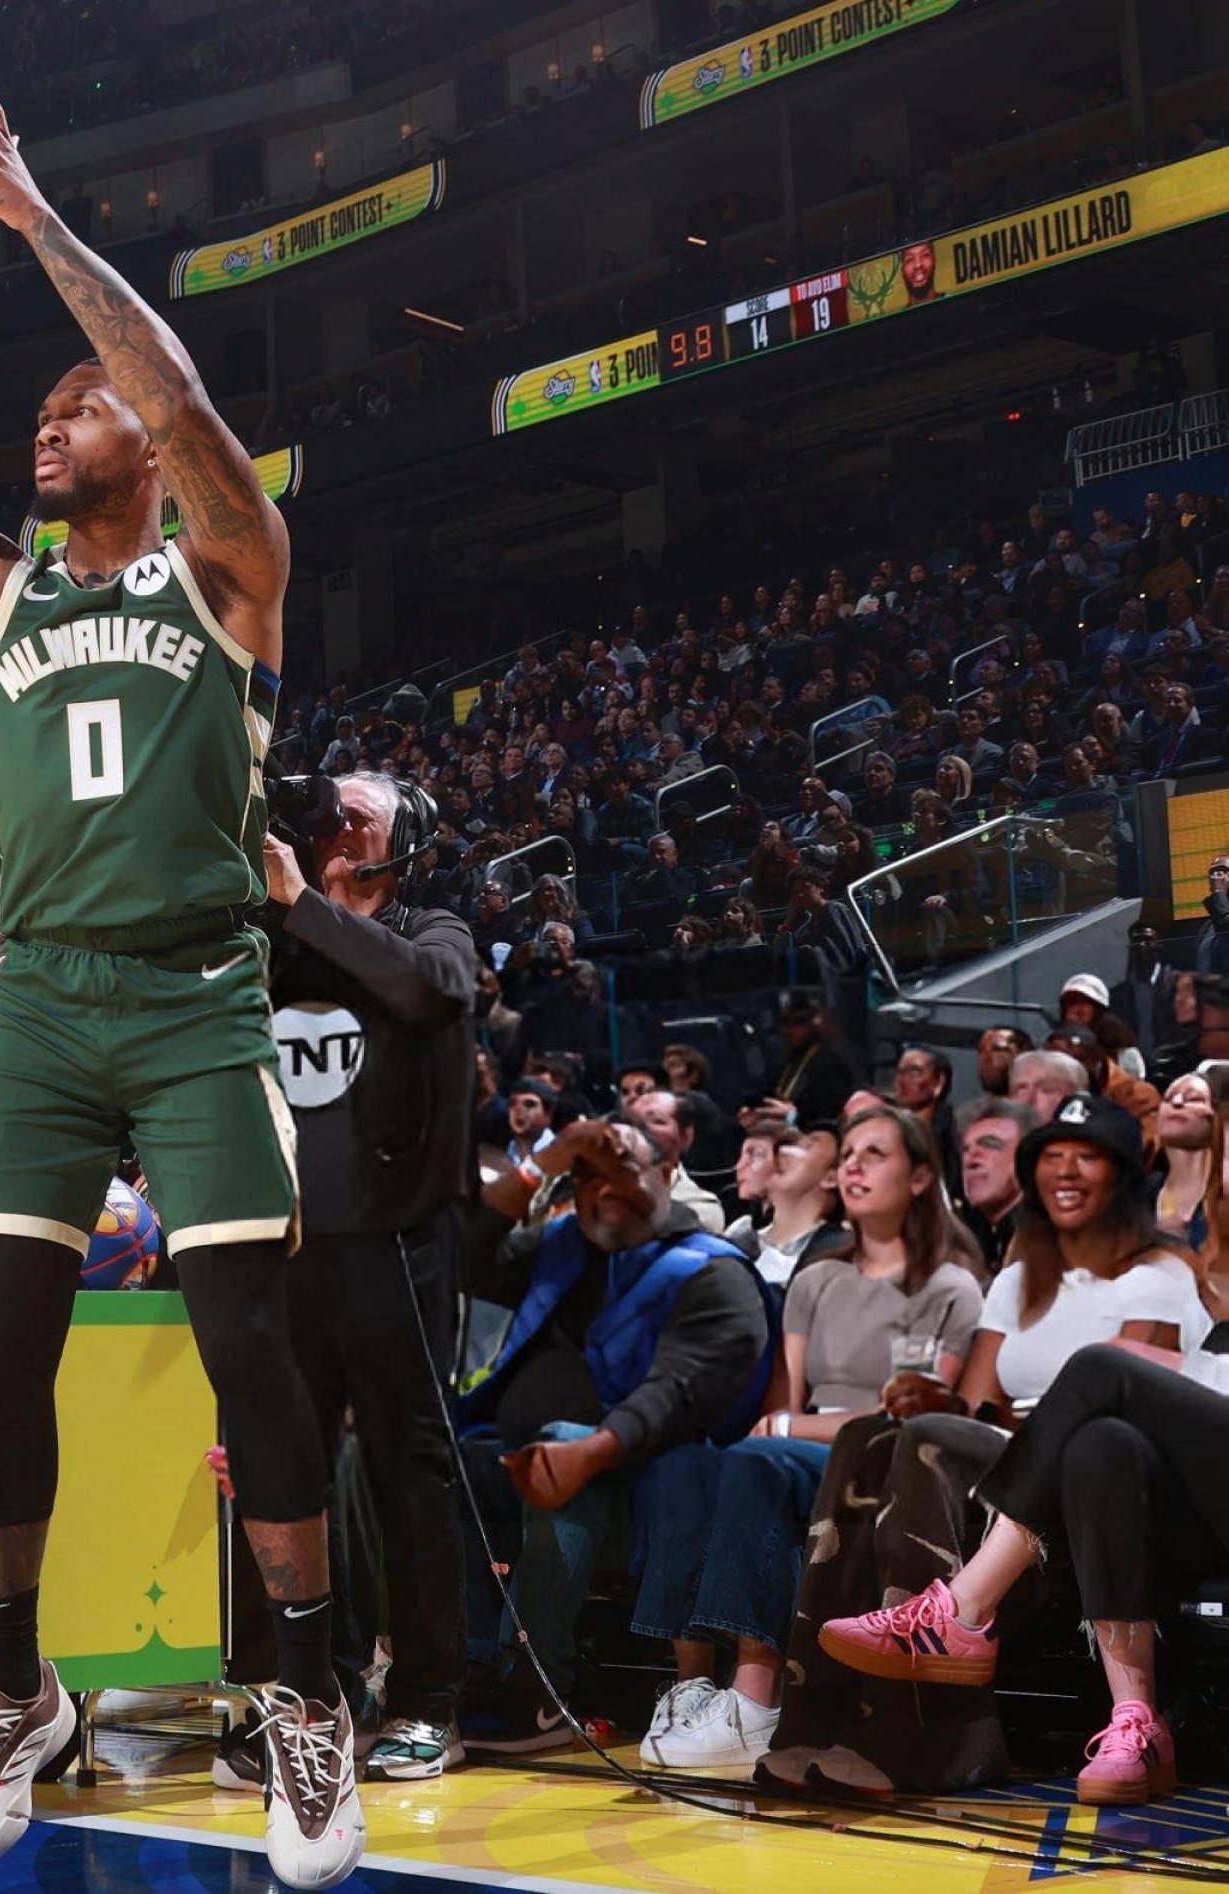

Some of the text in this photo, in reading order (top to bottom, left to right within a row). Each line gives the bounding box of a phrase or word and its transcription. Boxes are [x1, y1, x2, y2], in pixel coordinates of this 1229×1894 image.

[759, 0, 901, 72] 3 POINT CONTEST
[277, 193, 384, 260] 3 POINT CONTEST
[953, 190, 1132, 284] DAMIAN LILLARD
[750, 316, 769, 350] 14
[811, 297, 831, 331] 19
[608, 354, 619, 388] 3
[671, 324, 711, 367] 9.8
[67, 699, 124, 801] 0
